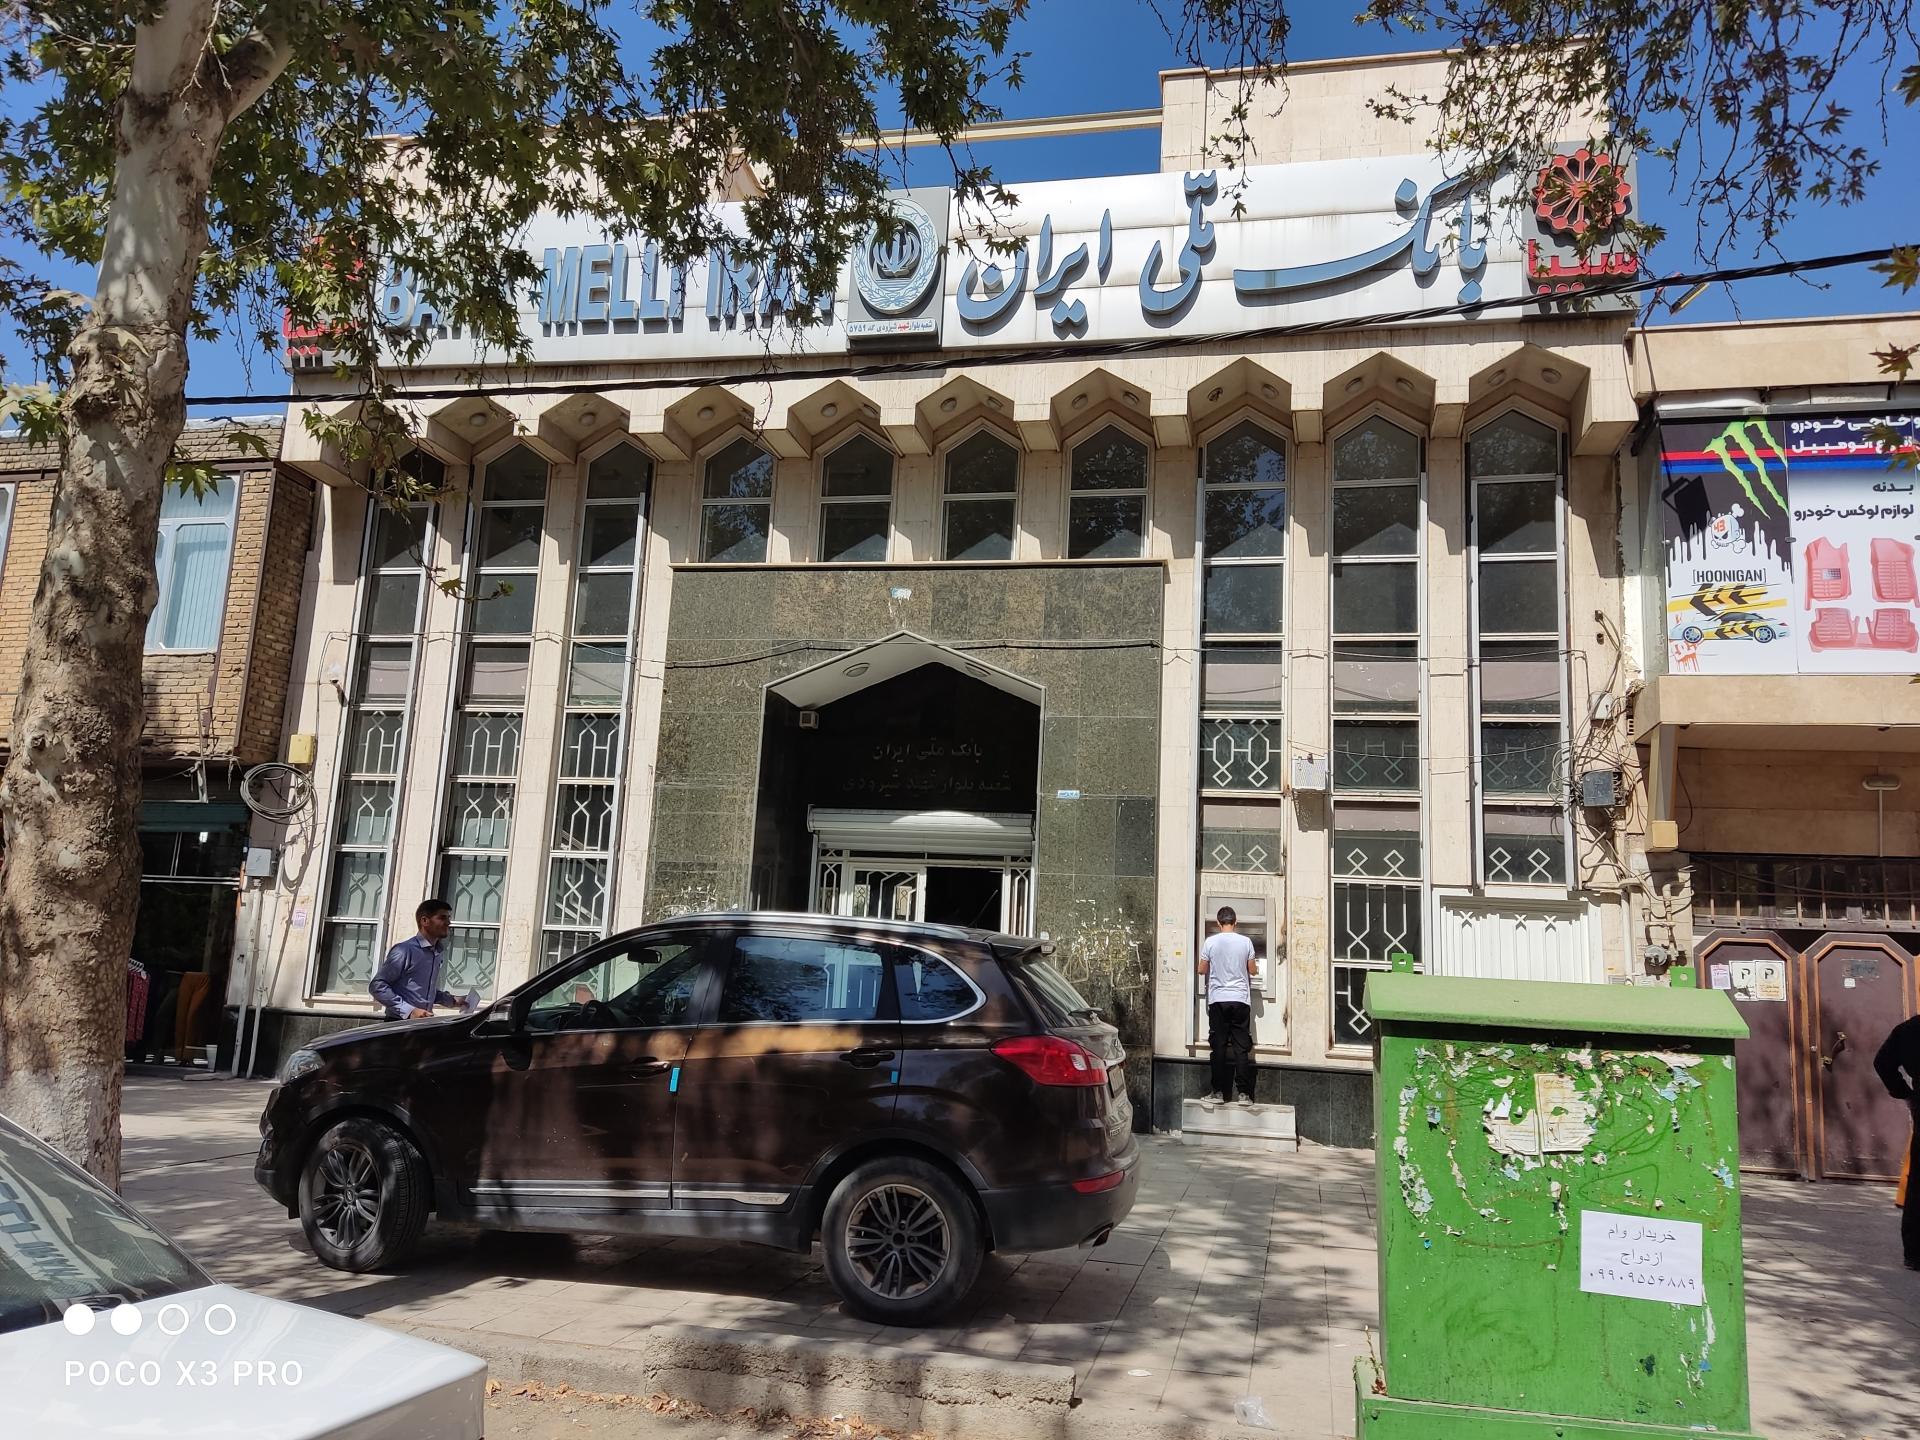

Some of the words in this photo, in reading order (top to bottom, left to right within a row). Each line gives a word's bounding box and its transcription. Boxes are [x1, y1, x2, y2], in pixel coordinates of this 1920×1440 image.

[1233, 150, 1518, 305] بانک
[956, 207, 1112, 327] ایران
[538, 243, 686, 326] MELLI
[1791, 416, 1846, 434] خودرو
[1872, 481, 1914, 495] بدنه
[1793, 504, 1836, 521] خودرو
[1837, 504, 1879, 519] لوکس
[1881, 504, 1914, 519] لوازم
[871, 743, 911, 763] ایران
[1608, 1223, 1628, 1240] وام
[1632, 1226, 1677, 1244] خریدار
[1620, 1248, 1663, 1267] ازدواج
